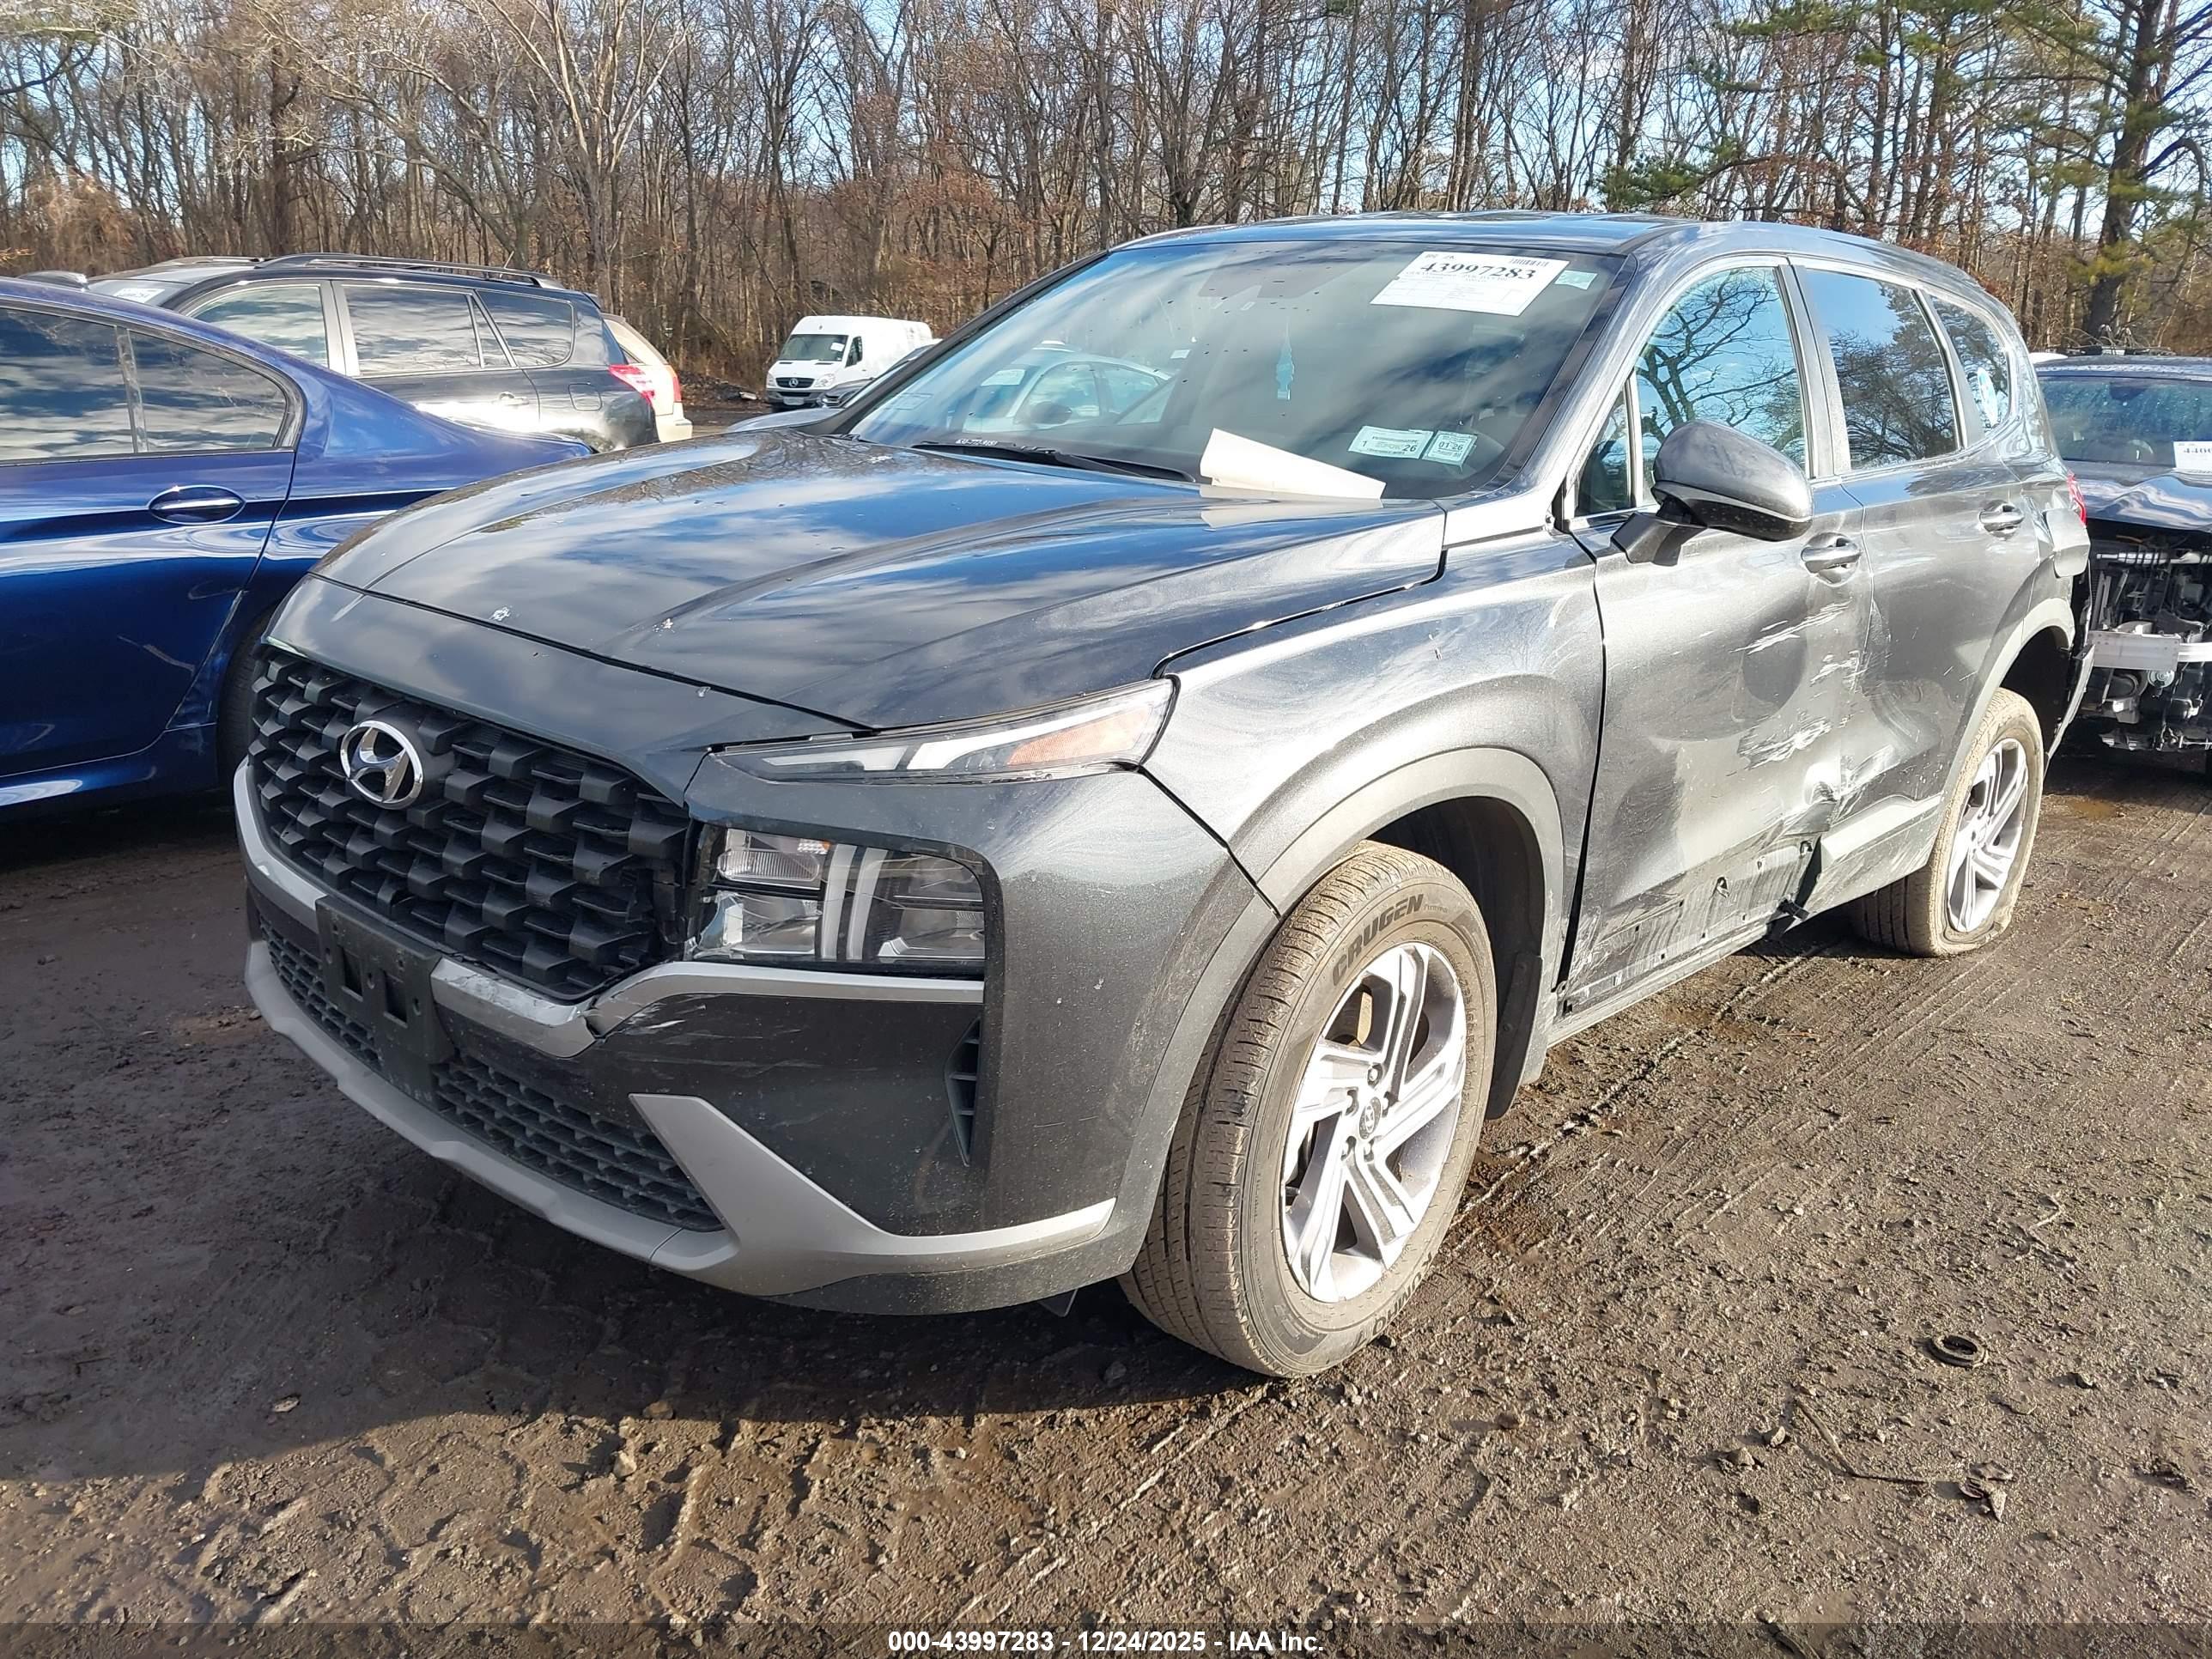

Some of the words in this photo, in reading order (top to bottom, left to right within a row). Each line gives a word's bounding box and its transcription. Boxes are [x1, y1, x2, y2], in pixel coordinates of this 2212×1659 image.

[1420, 261, 1537, 281] 43997283
[1402, 444, 1418, 453] 26
[1332, 893, 1425, 987] CRUGEN
[1373, 1251, 1432, 1334] KUMHO
